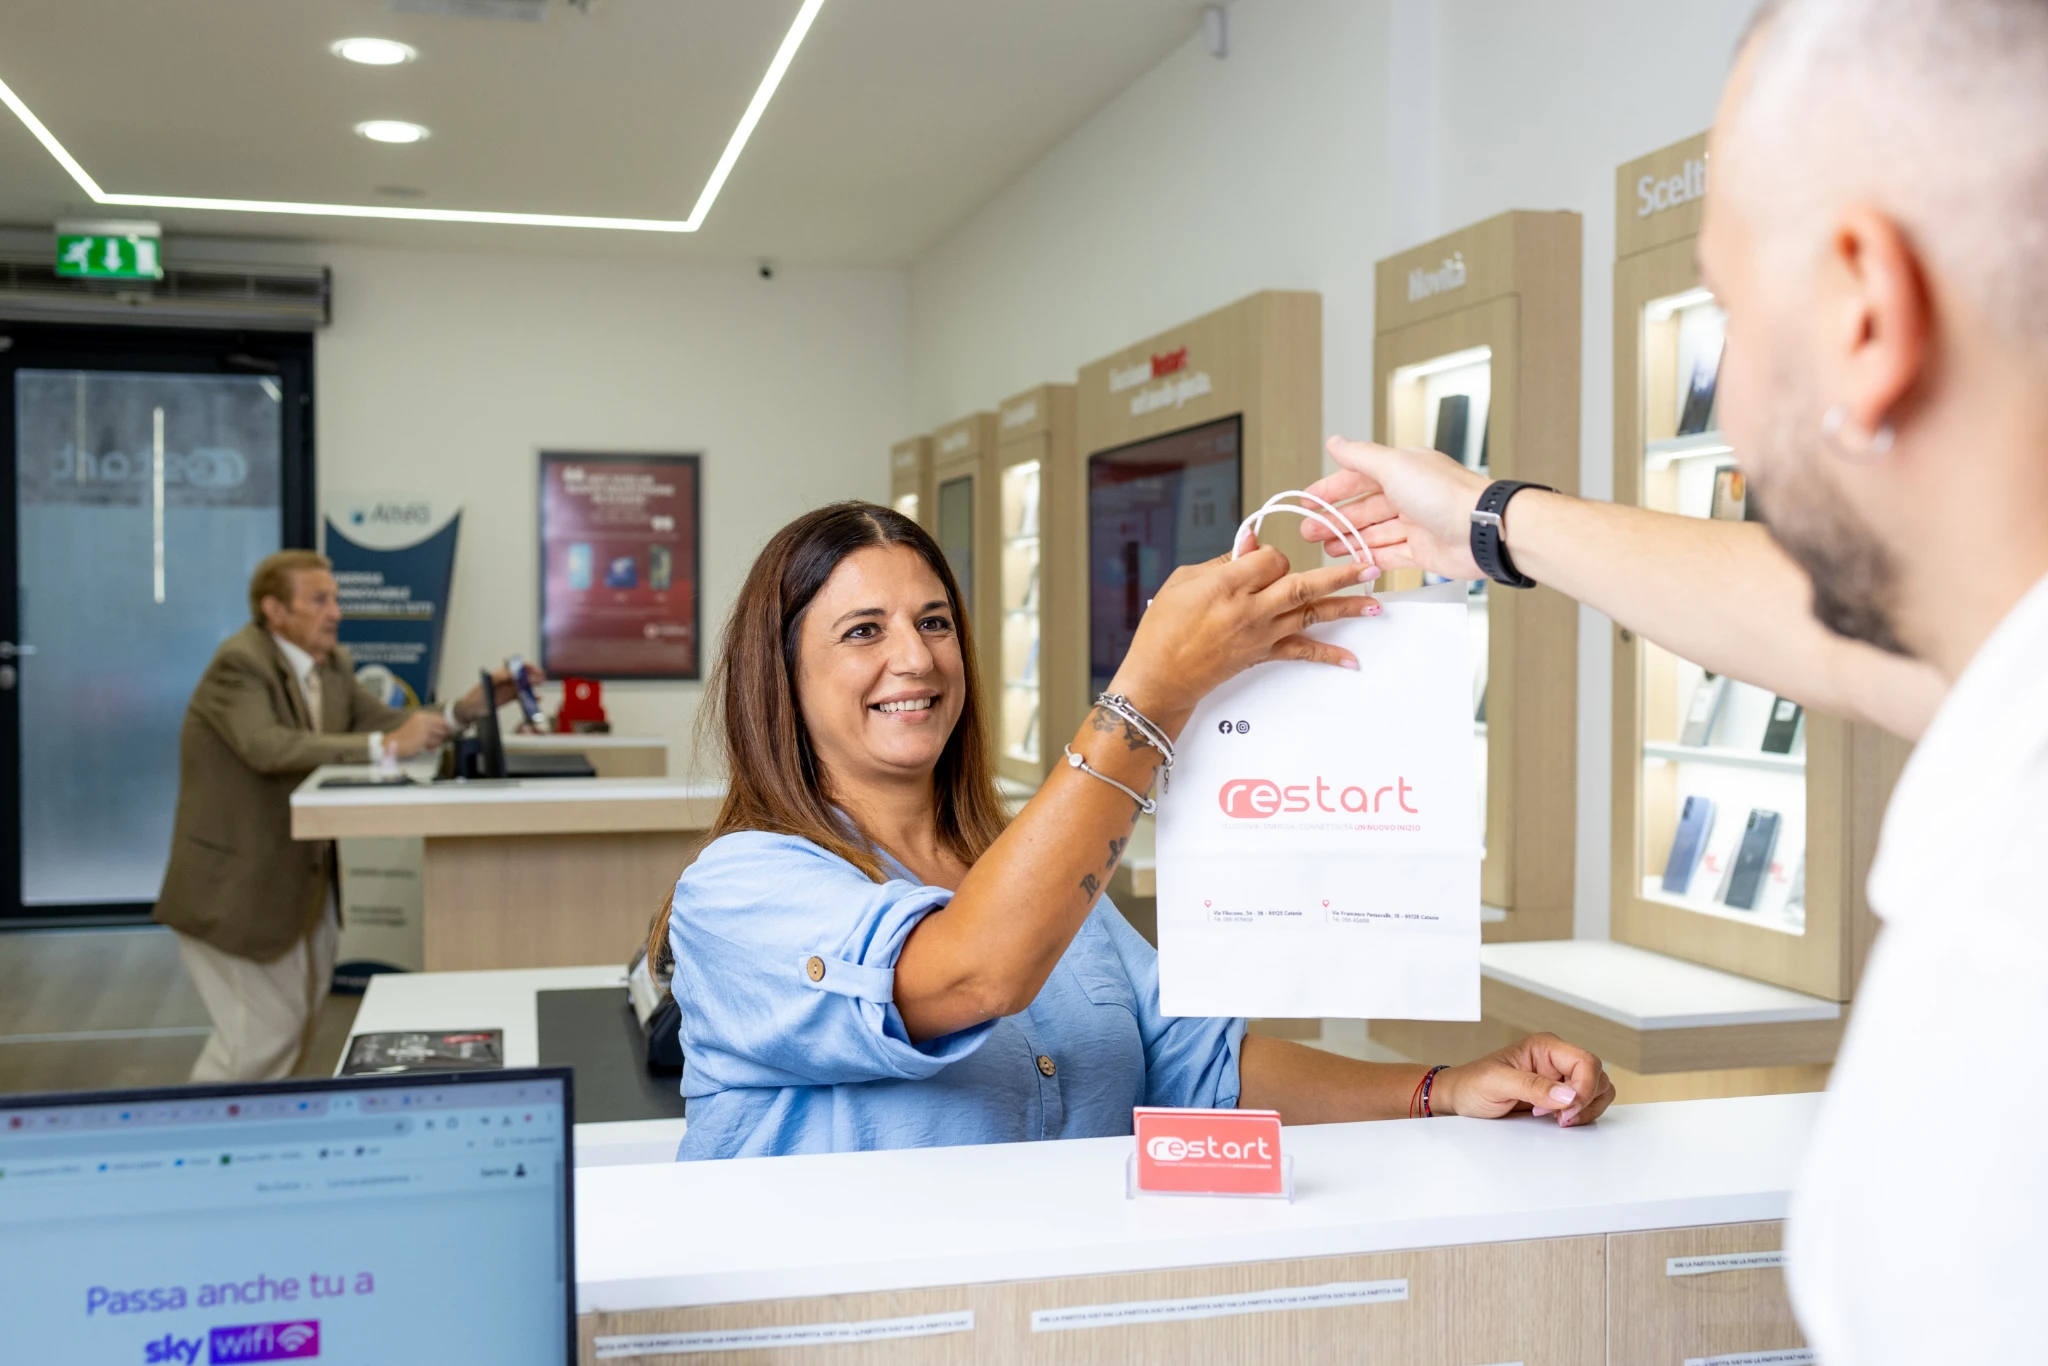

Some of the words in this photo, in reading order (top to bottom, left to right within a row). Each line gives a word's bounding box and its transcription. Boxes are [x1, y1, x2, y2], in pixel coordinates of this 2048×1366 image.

[1218, 776, 1418, 818] restart
[1147, 1135, 1272, 1161] restart
[1693, 1260, 1715, 1268] PARTITA
[1747, 1257, 1769, 1265] PARTITA
[86, 1286, 188, 1316] Passa
[197, 1274, 301, 1307] anche
[310, 1272, 344, 1298] tu
[354, 1272, 374, 1294] a
[144, 1333, 204, 1366] sky
[213, 1325, 275, 1358] wifi
[1762, 1355, 1783, 1363] PARTITA
